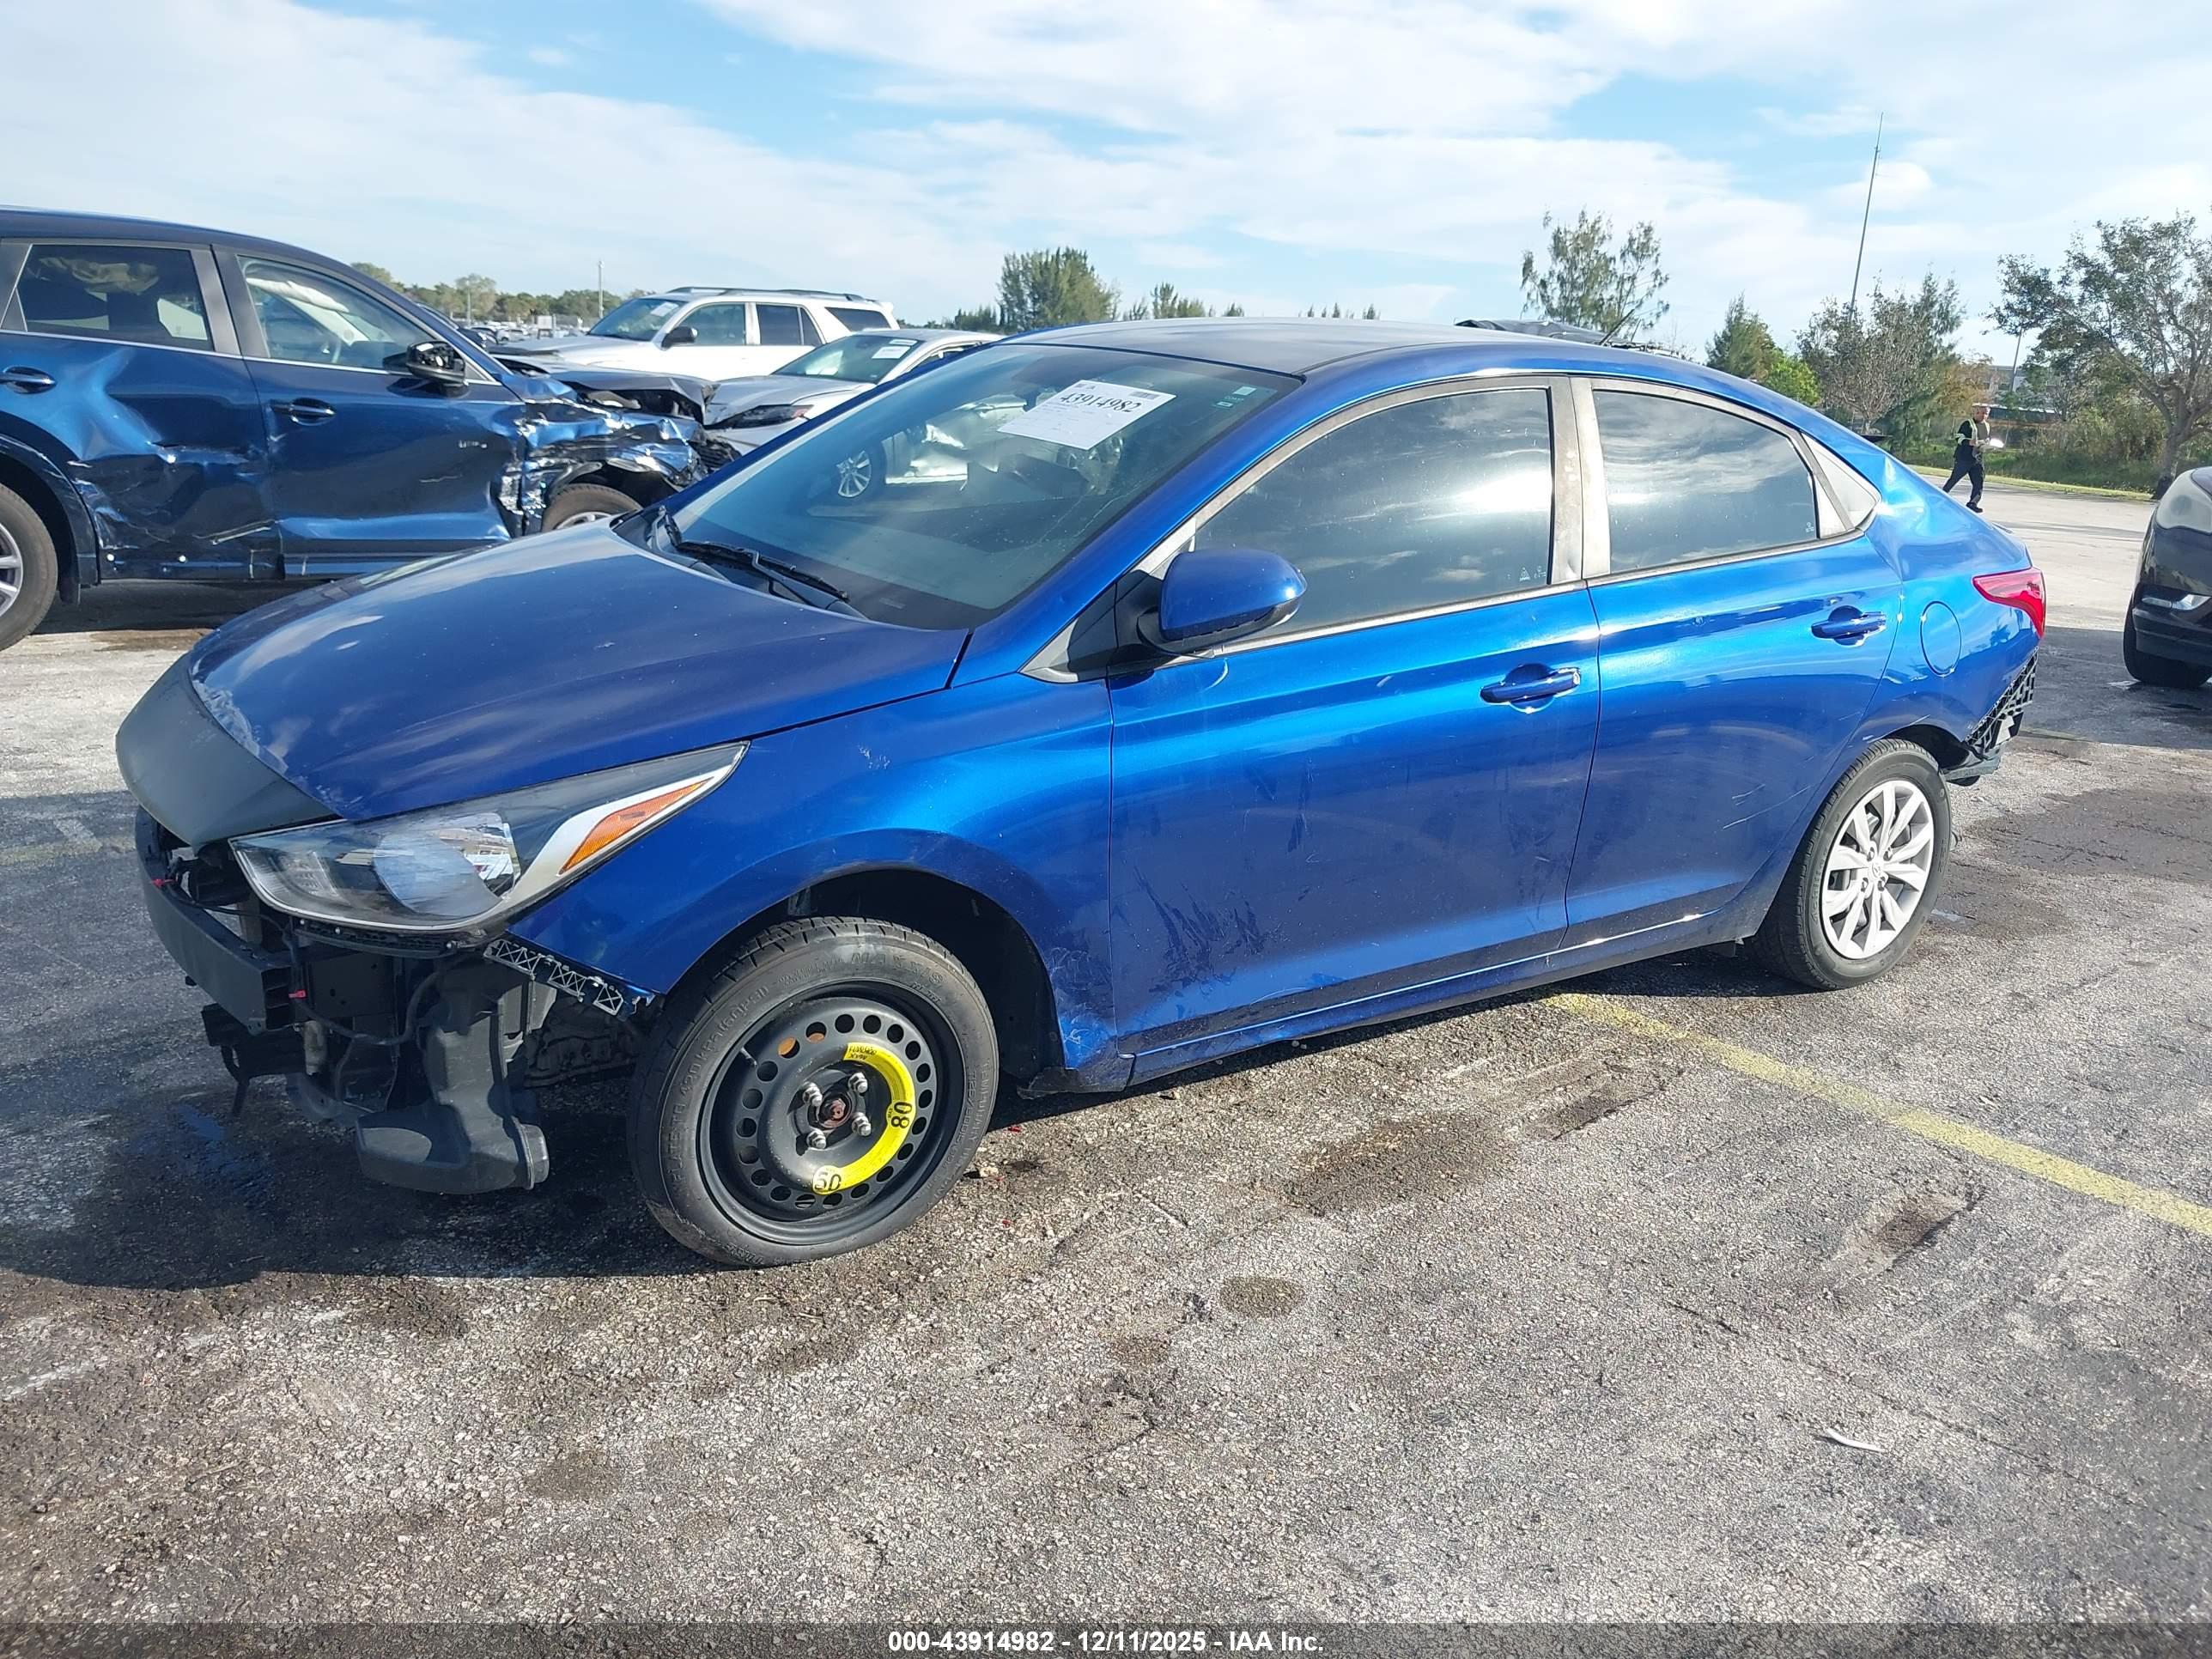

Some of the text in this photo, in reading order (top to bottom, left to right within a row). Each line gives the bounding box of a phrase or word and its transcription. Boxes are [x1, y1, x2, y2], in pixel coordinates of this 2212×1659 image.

[1060, 392, 1142, 412] 43914982
[891, 1102, 912, 1128] 80
[814, 1172, 842, 1191] 50
